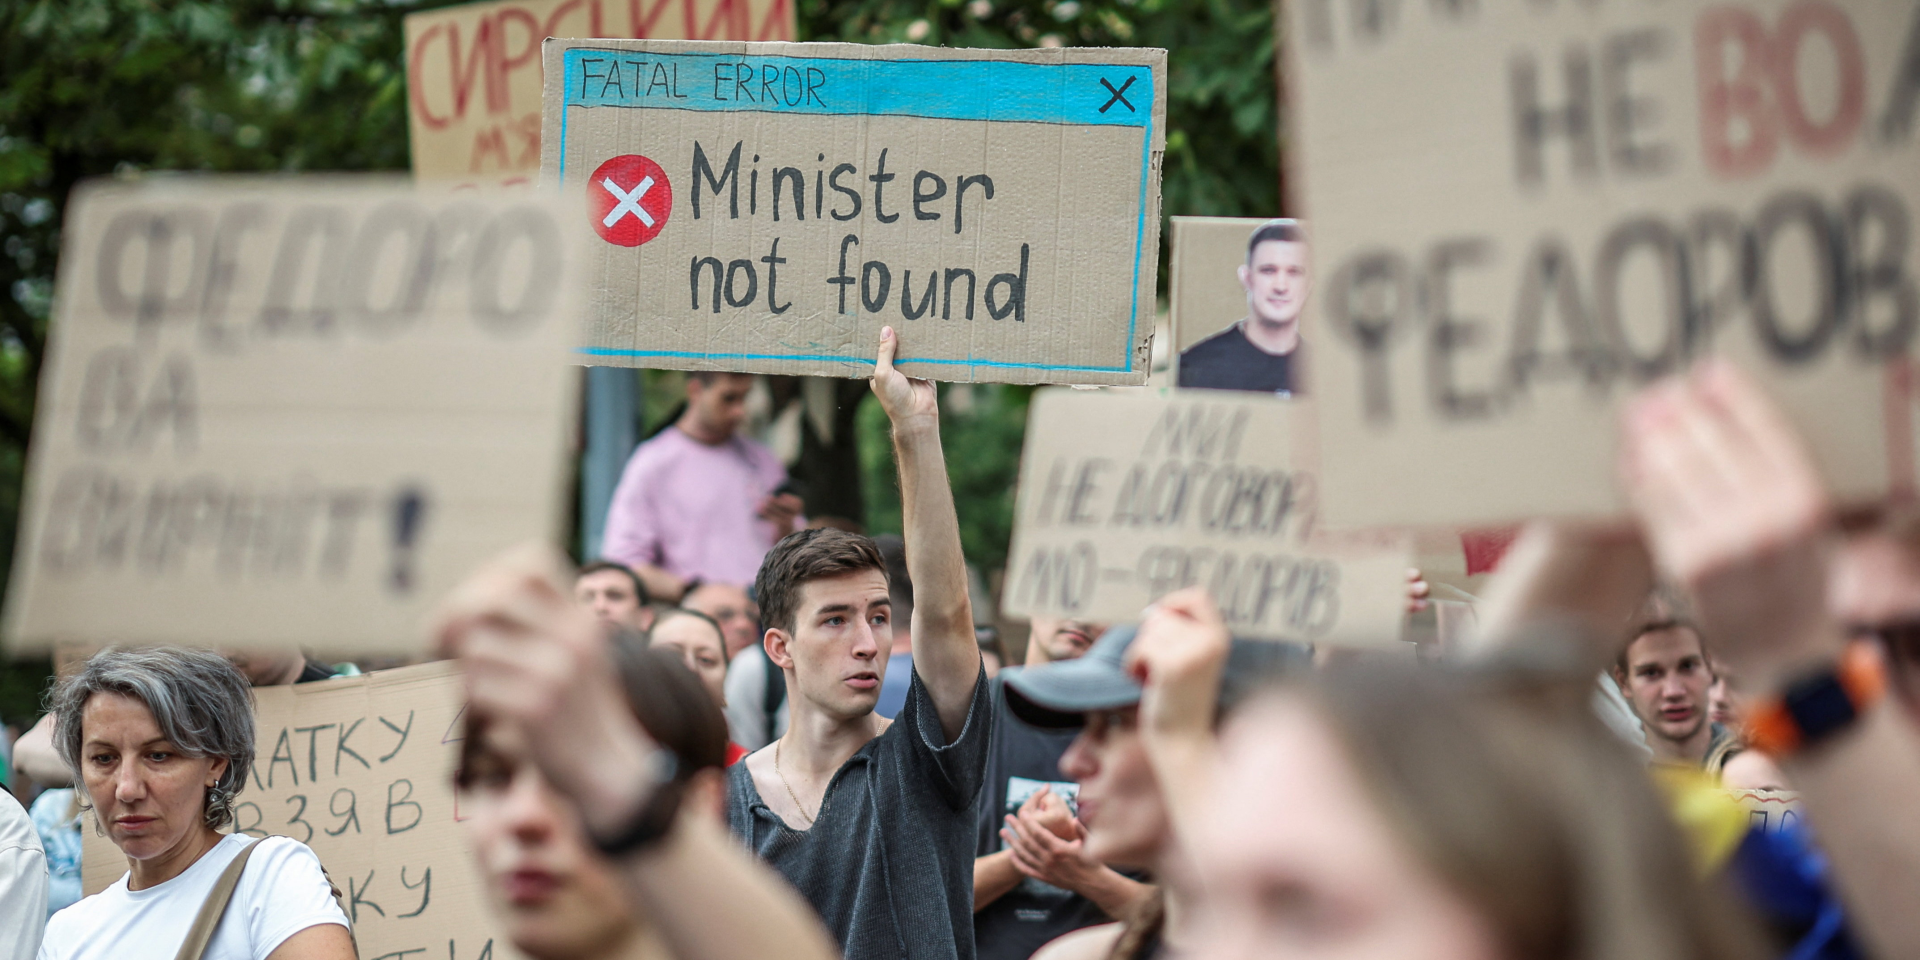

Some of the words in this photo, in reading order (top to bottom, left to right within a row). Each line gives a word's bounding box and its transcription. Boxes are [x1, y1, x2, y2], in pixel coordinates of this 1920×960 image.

[580, 58, 688, 100] FATAL
[714, 62, 828, 108] ERROR
[691, 140, 995, 234] Minister
[690, 237, 792, 314] not
[827, 234, 1030, 324] found
